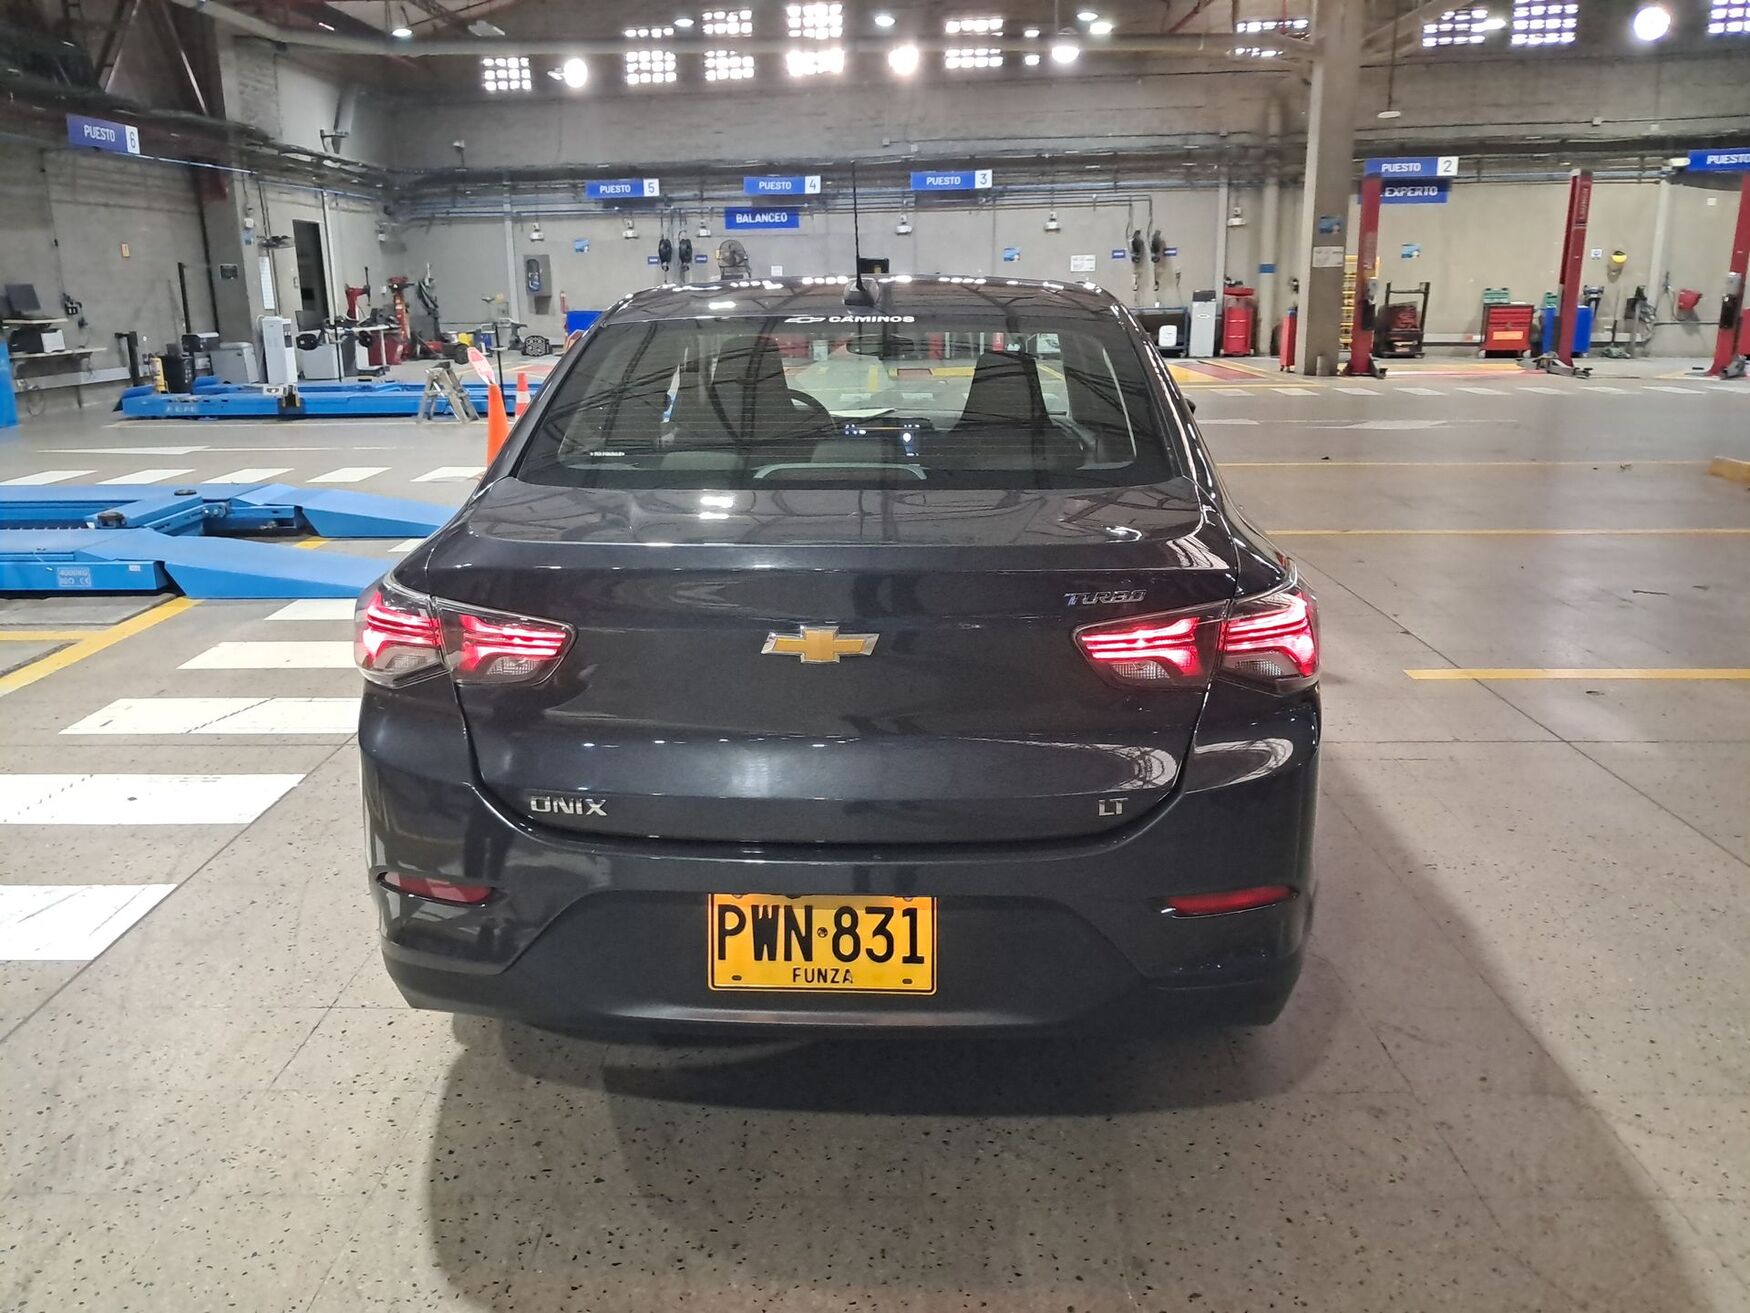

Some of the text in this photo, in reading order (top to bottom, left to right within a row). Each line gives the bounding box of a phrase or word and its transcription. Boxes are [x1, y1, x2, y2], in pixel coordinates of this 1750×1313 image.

[84, 125, 136, 149] PUESTO 6
[1381, 160, 1453, 173] PUESTO 2
[758, 179, 817, 191] PUESTO 4
[926, 173, 988, 186] PUESTO 3
[600, 182, 655, 194] PUESTO 5
[1384, 186, 1438, 197] EXPERTO
[736, 212, 788, 224] BALANCEO
[1064, 589, 1147, 606] TURBO
[530, 796, 608, 816] ONIX
[1099, 798, 1129, 816] LT
[717, 904, 925, 964] PWN 831
[792, 967, 854, 984] FUNZA
